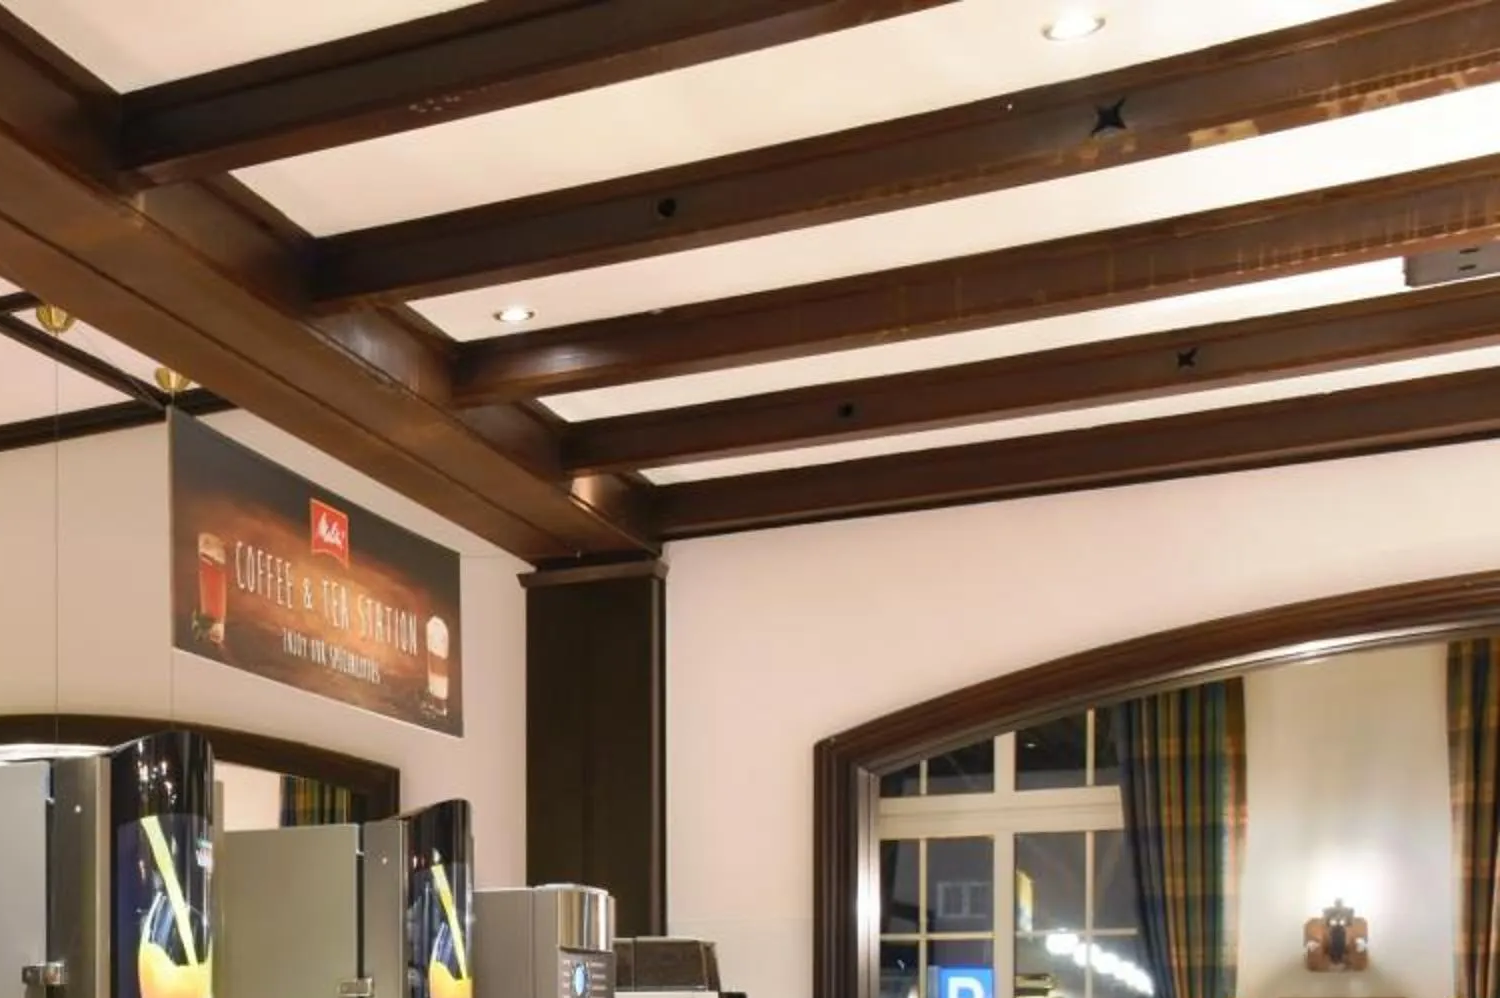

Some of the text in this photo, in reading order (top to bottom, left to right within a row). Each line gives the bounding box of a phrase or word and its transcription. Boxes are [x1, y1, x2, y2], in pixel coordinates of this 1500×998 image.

[235, 540, 418, 656] COFFEE & TEA STATION
